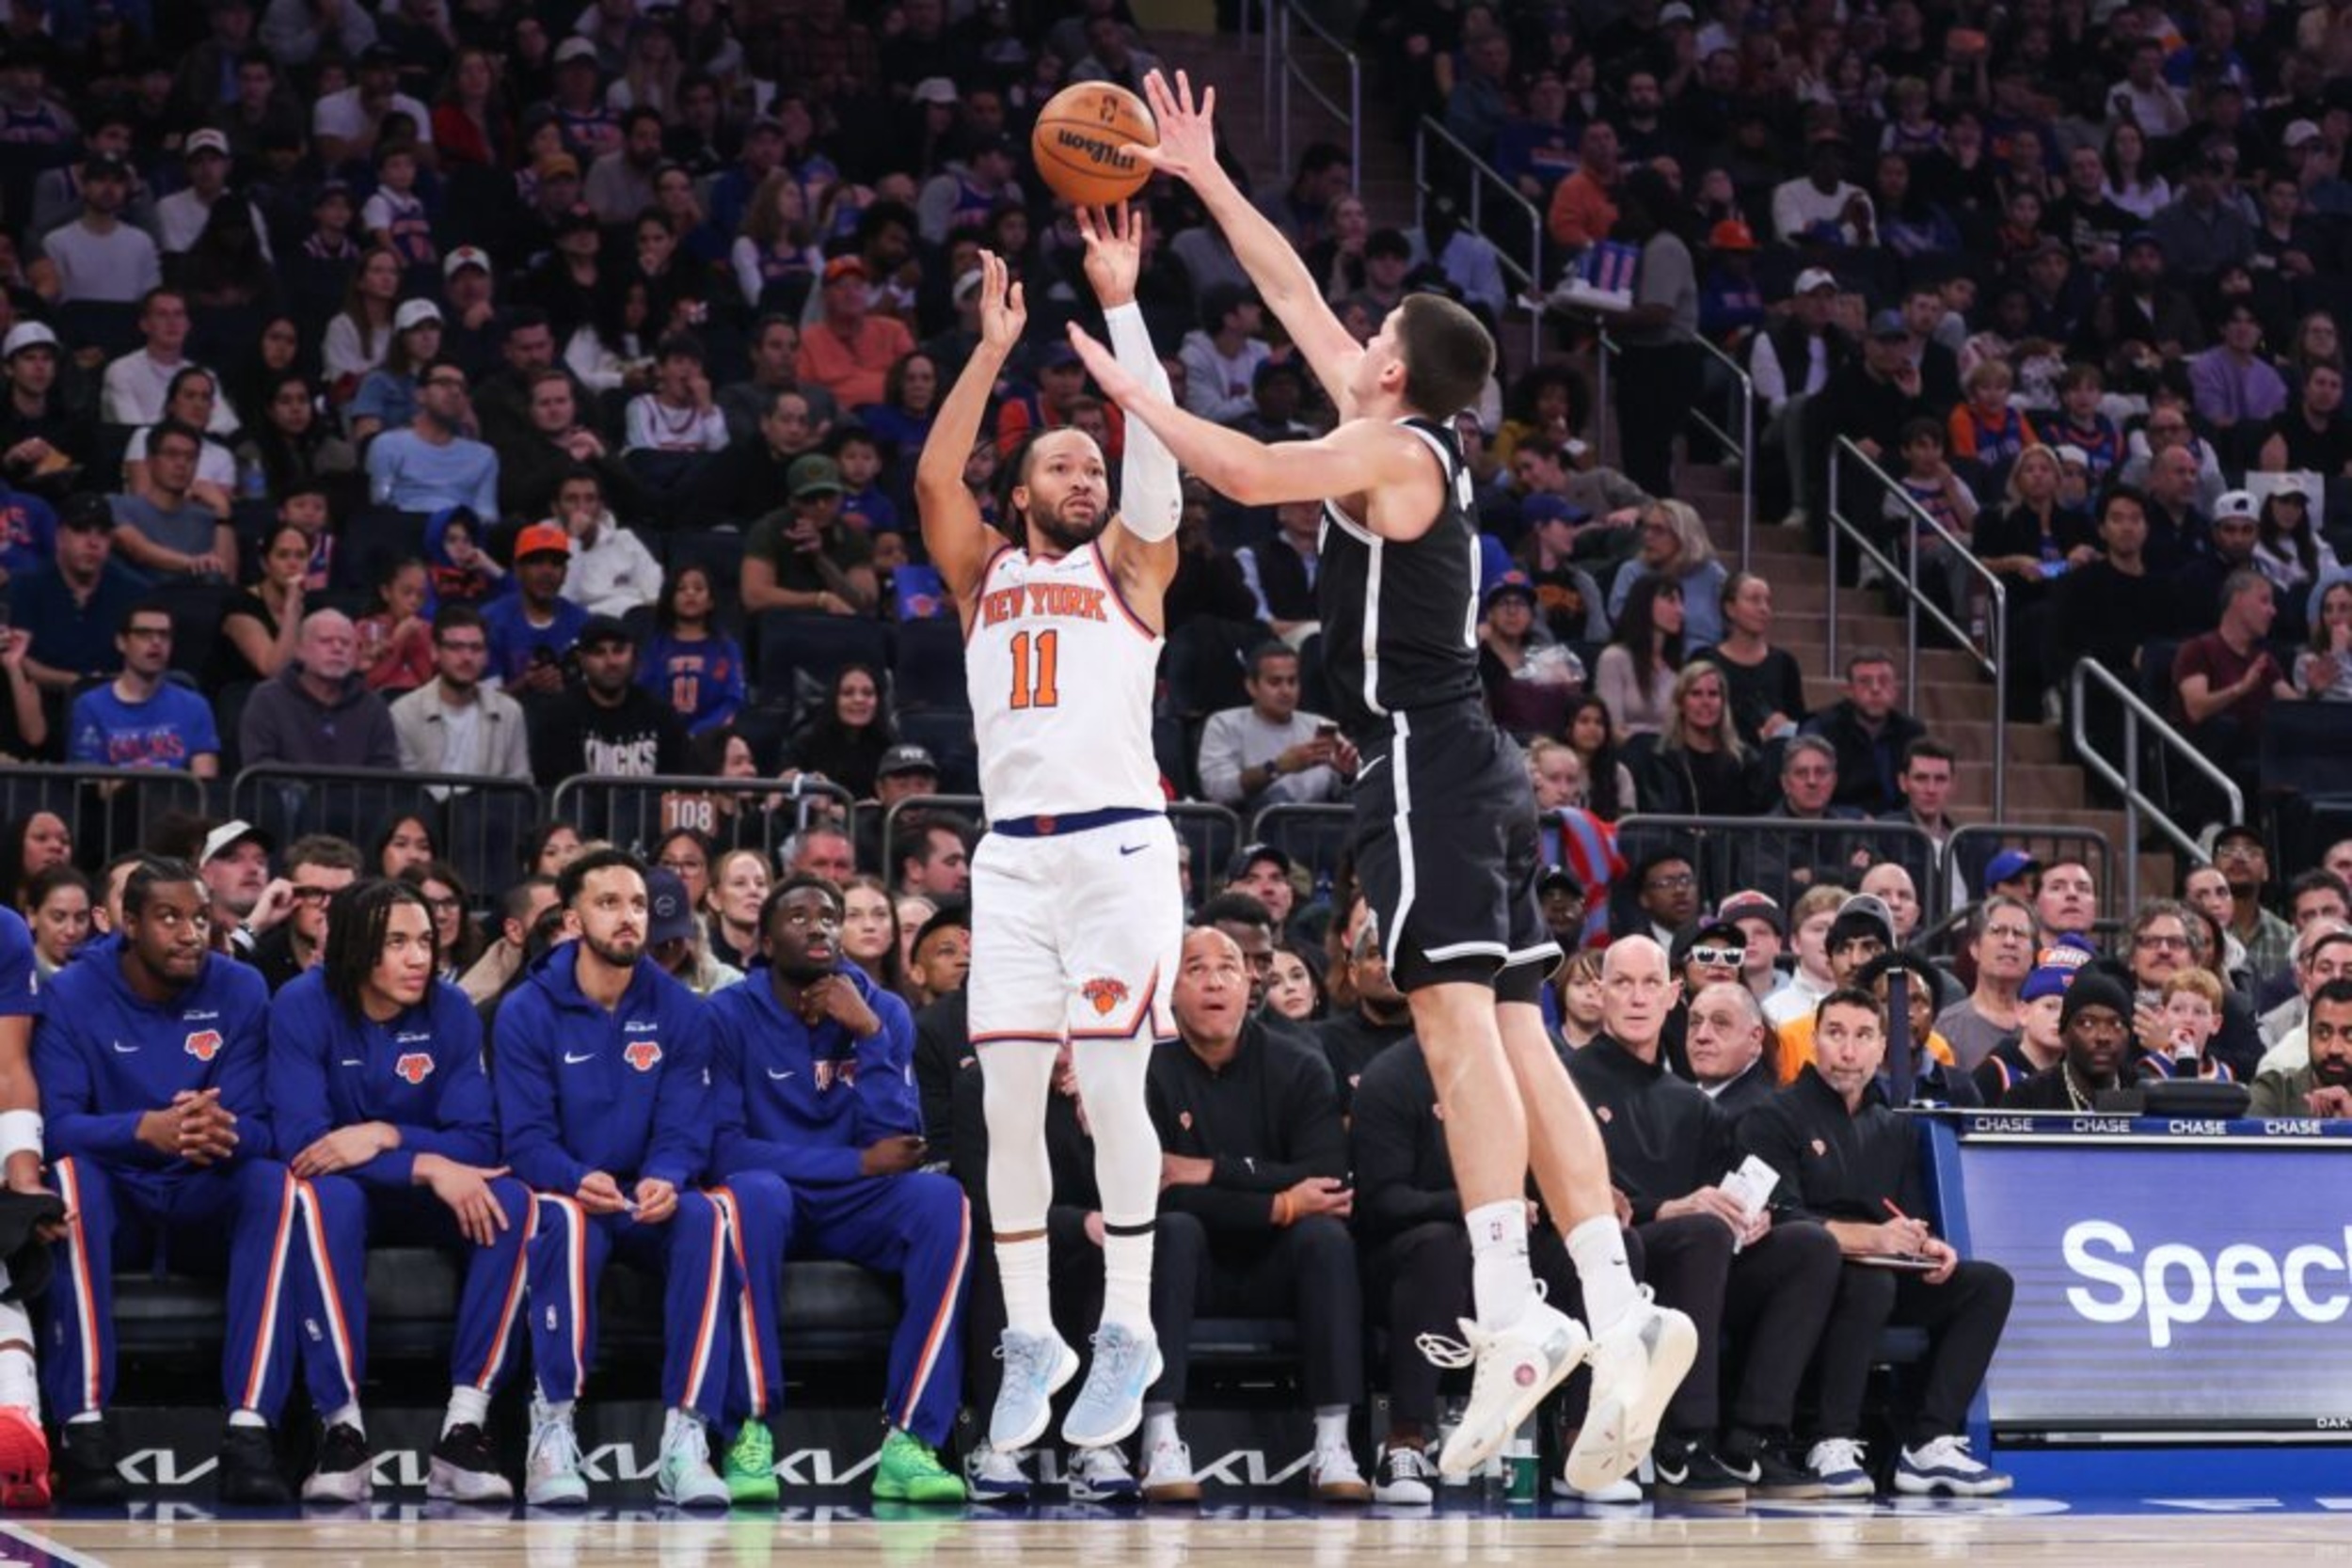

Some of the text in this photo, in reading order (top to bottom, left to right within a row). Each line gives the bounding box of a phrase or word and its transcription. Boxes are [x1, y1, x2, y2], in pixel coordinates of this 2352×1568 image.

[1026, 582, 1107, 623] YORK
[1010, 628, 1057, 709] 11
[669, 800, 712, 832] 108
[1976, 1117, 2322, 1135] CHASE CHASE CHASE CHASE
[2062, 1220, 2352, 1348] Spec
[2317, 1418, 2352, 1429] DAK
